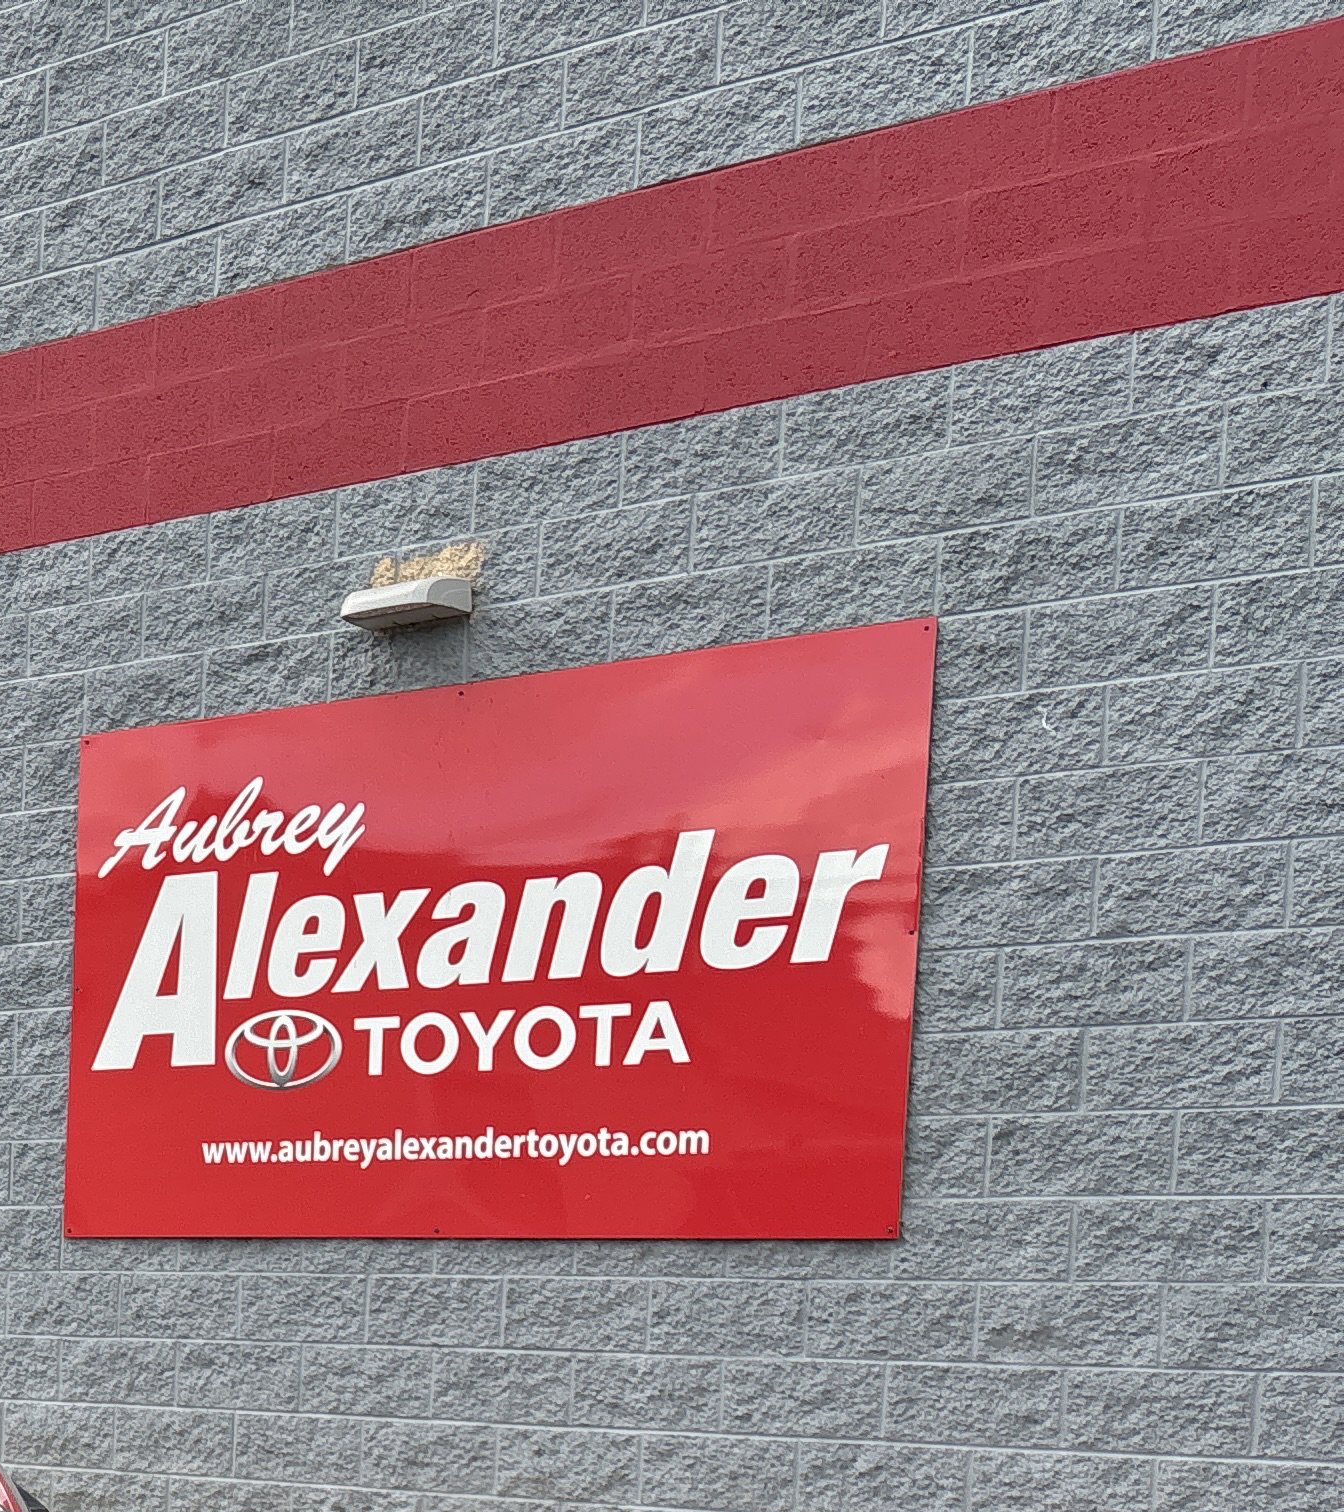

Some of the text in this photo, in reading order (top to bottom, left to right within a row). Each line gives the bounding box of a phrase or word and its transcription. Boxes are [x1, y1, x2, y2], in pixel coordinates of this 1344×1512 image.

[97, 776, 367, 879] Aubrey
[90, 828, 891, 1071] Alexander
[353, 1000, 692, 1077] TOYOTA
[201, 1126, 711, 1170] www.aubreyalexandertoyota.com
